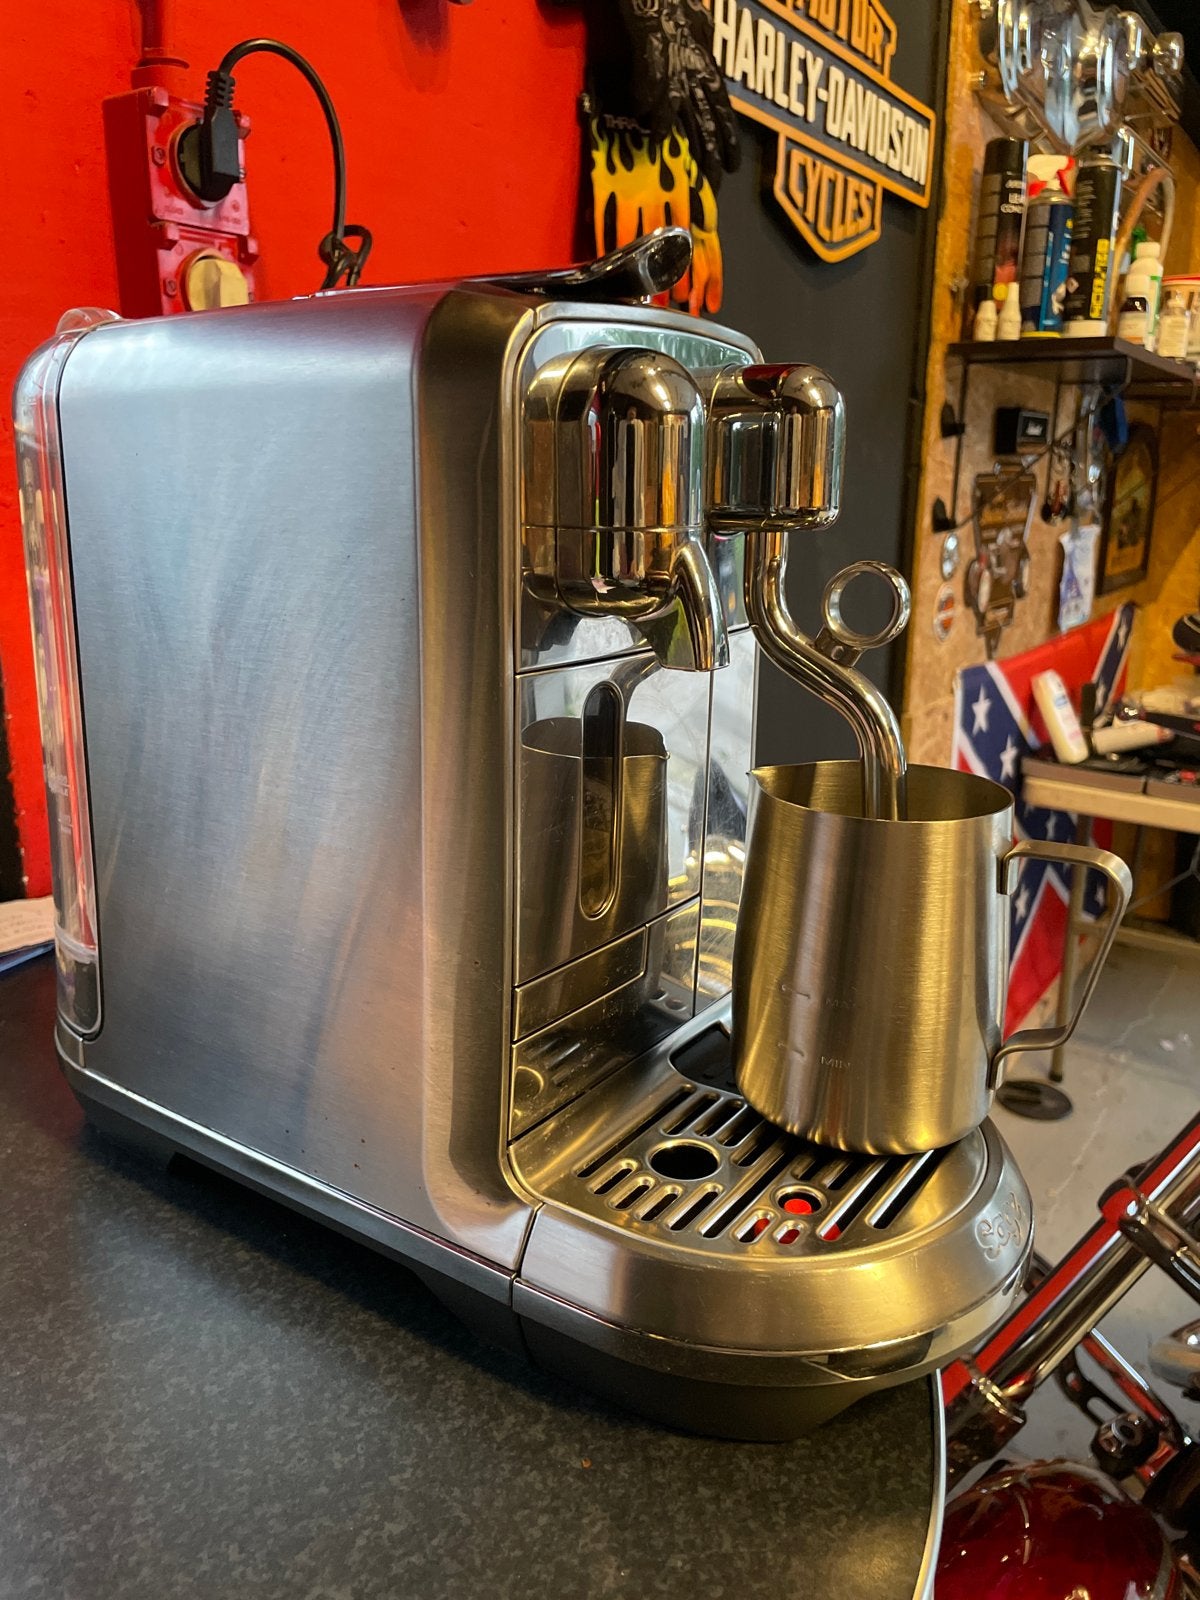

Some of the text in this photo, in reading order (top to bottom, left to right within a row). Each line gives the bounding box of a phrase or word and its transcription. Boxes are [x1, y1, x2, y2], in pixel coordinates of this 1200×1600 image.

[797, 0, 883, 66] OTOR
[714, 0, 929, 186] HARLEY-DAVIDSON
[788, 148, 874, 243] CYCLES
[821, 1056, 852, 1069] MIN
